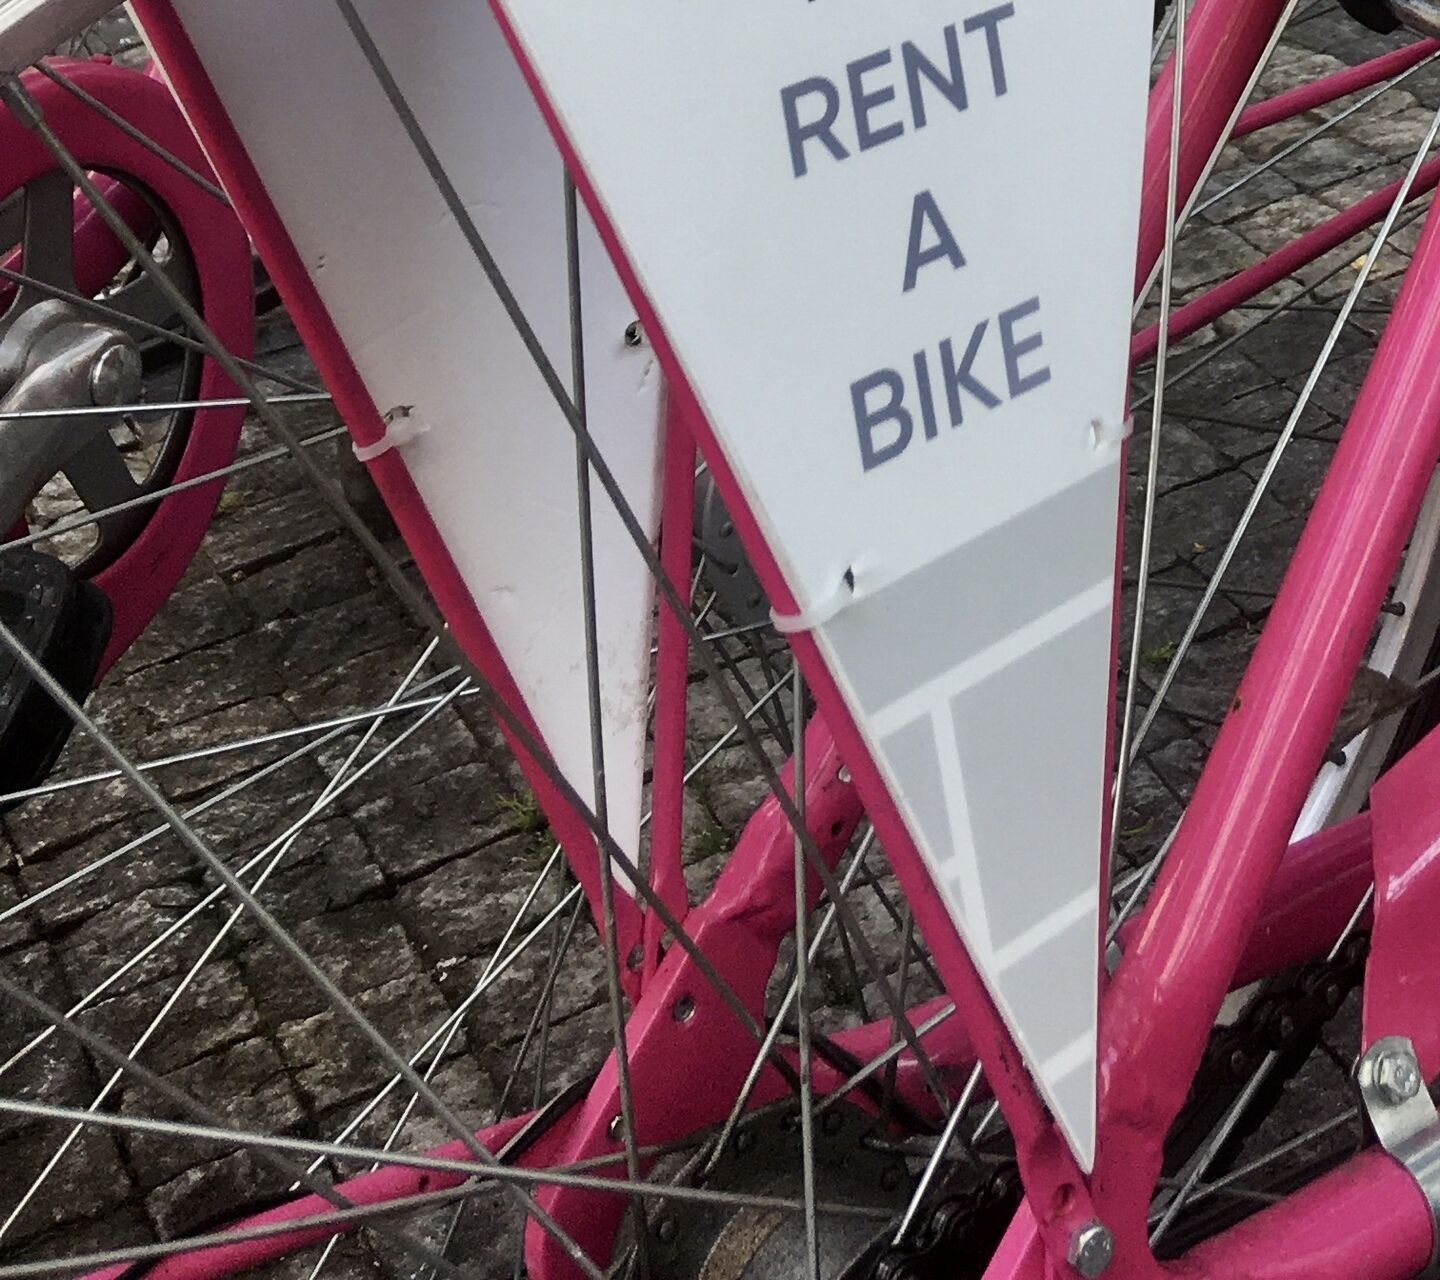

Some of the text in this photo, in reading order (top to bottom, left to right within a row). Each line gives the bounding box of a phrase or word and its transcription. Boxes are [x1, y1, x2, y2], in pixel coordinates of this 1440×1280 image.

[779, 1, 1015, 178] RENT
[902, 189, 966, 294] A
[850, 295, 1052, 473] BIKE
